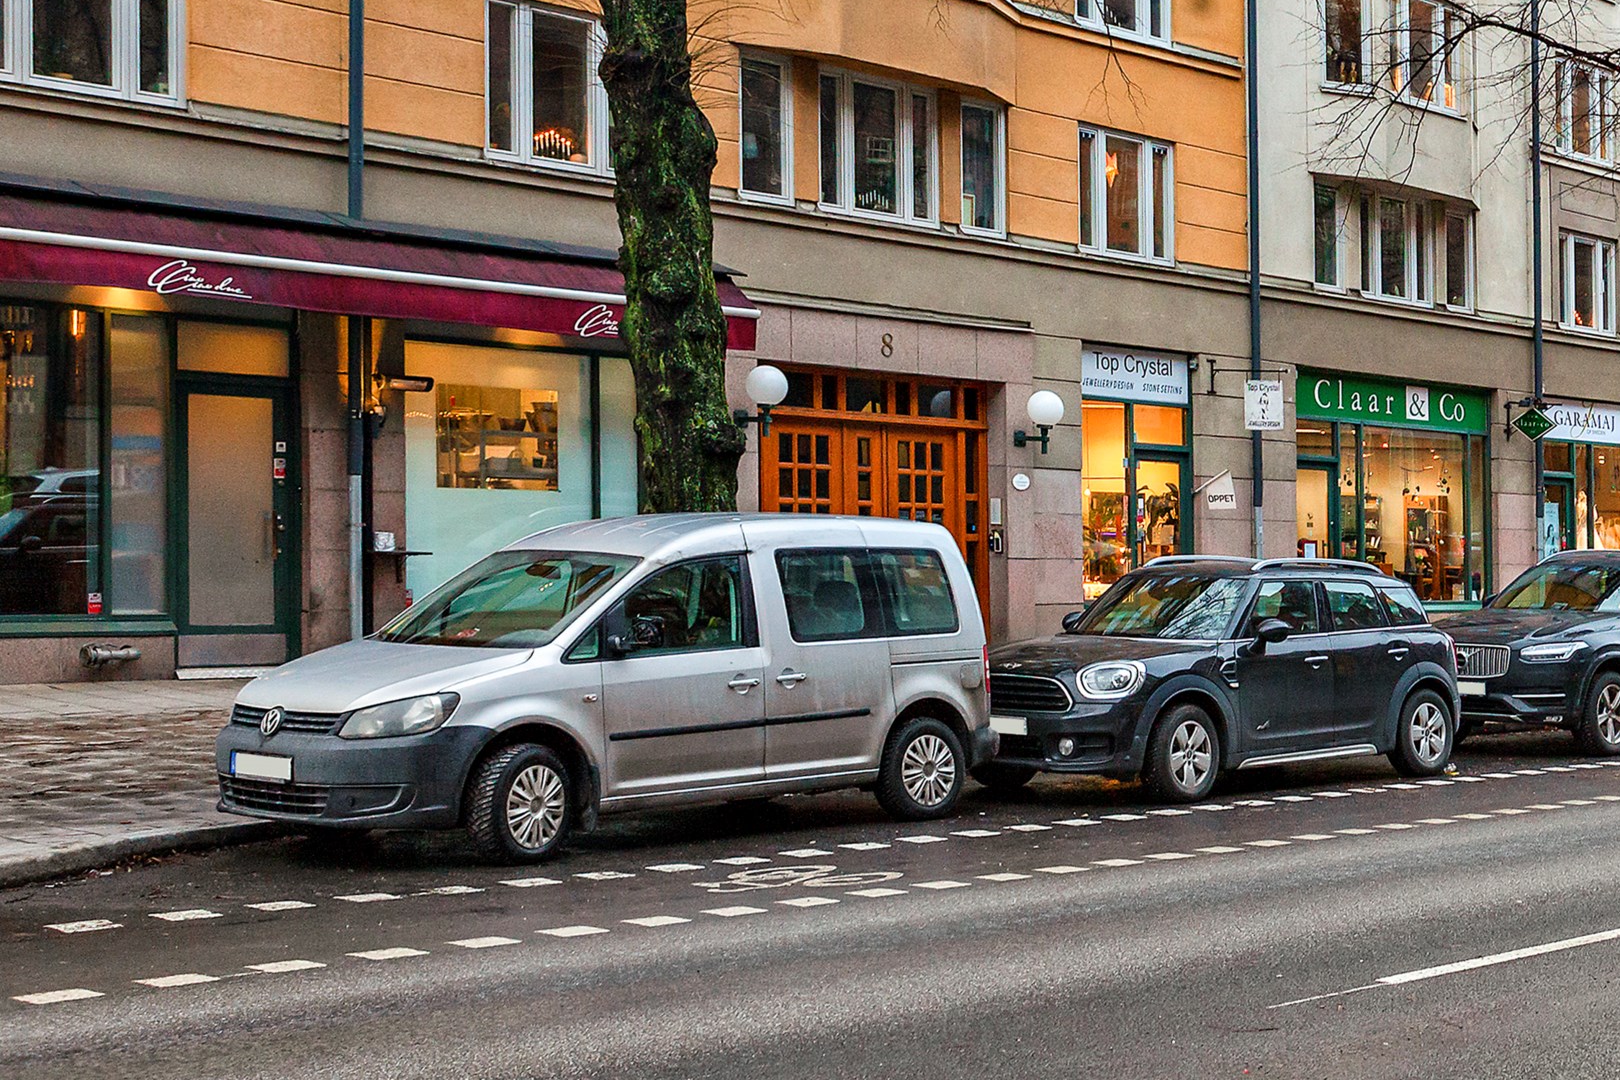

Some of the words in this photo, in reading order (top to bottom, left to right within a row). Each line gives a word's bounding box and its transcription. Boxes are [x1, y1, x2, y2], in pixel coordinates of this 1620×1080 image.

[881, 332, 894, 358] 8
[1092, 351, 1119, 375] Top
[1123, 354, 1173, 379] Crystal
[1247, 383, 1258, 392] Top
[1314, 379, 1394, 415] Claar
[1409, 392, 1425, 418] &
[1439, 393, 1465, 422] Co
[1553, 410, 1615, 432] GARAMAJ
